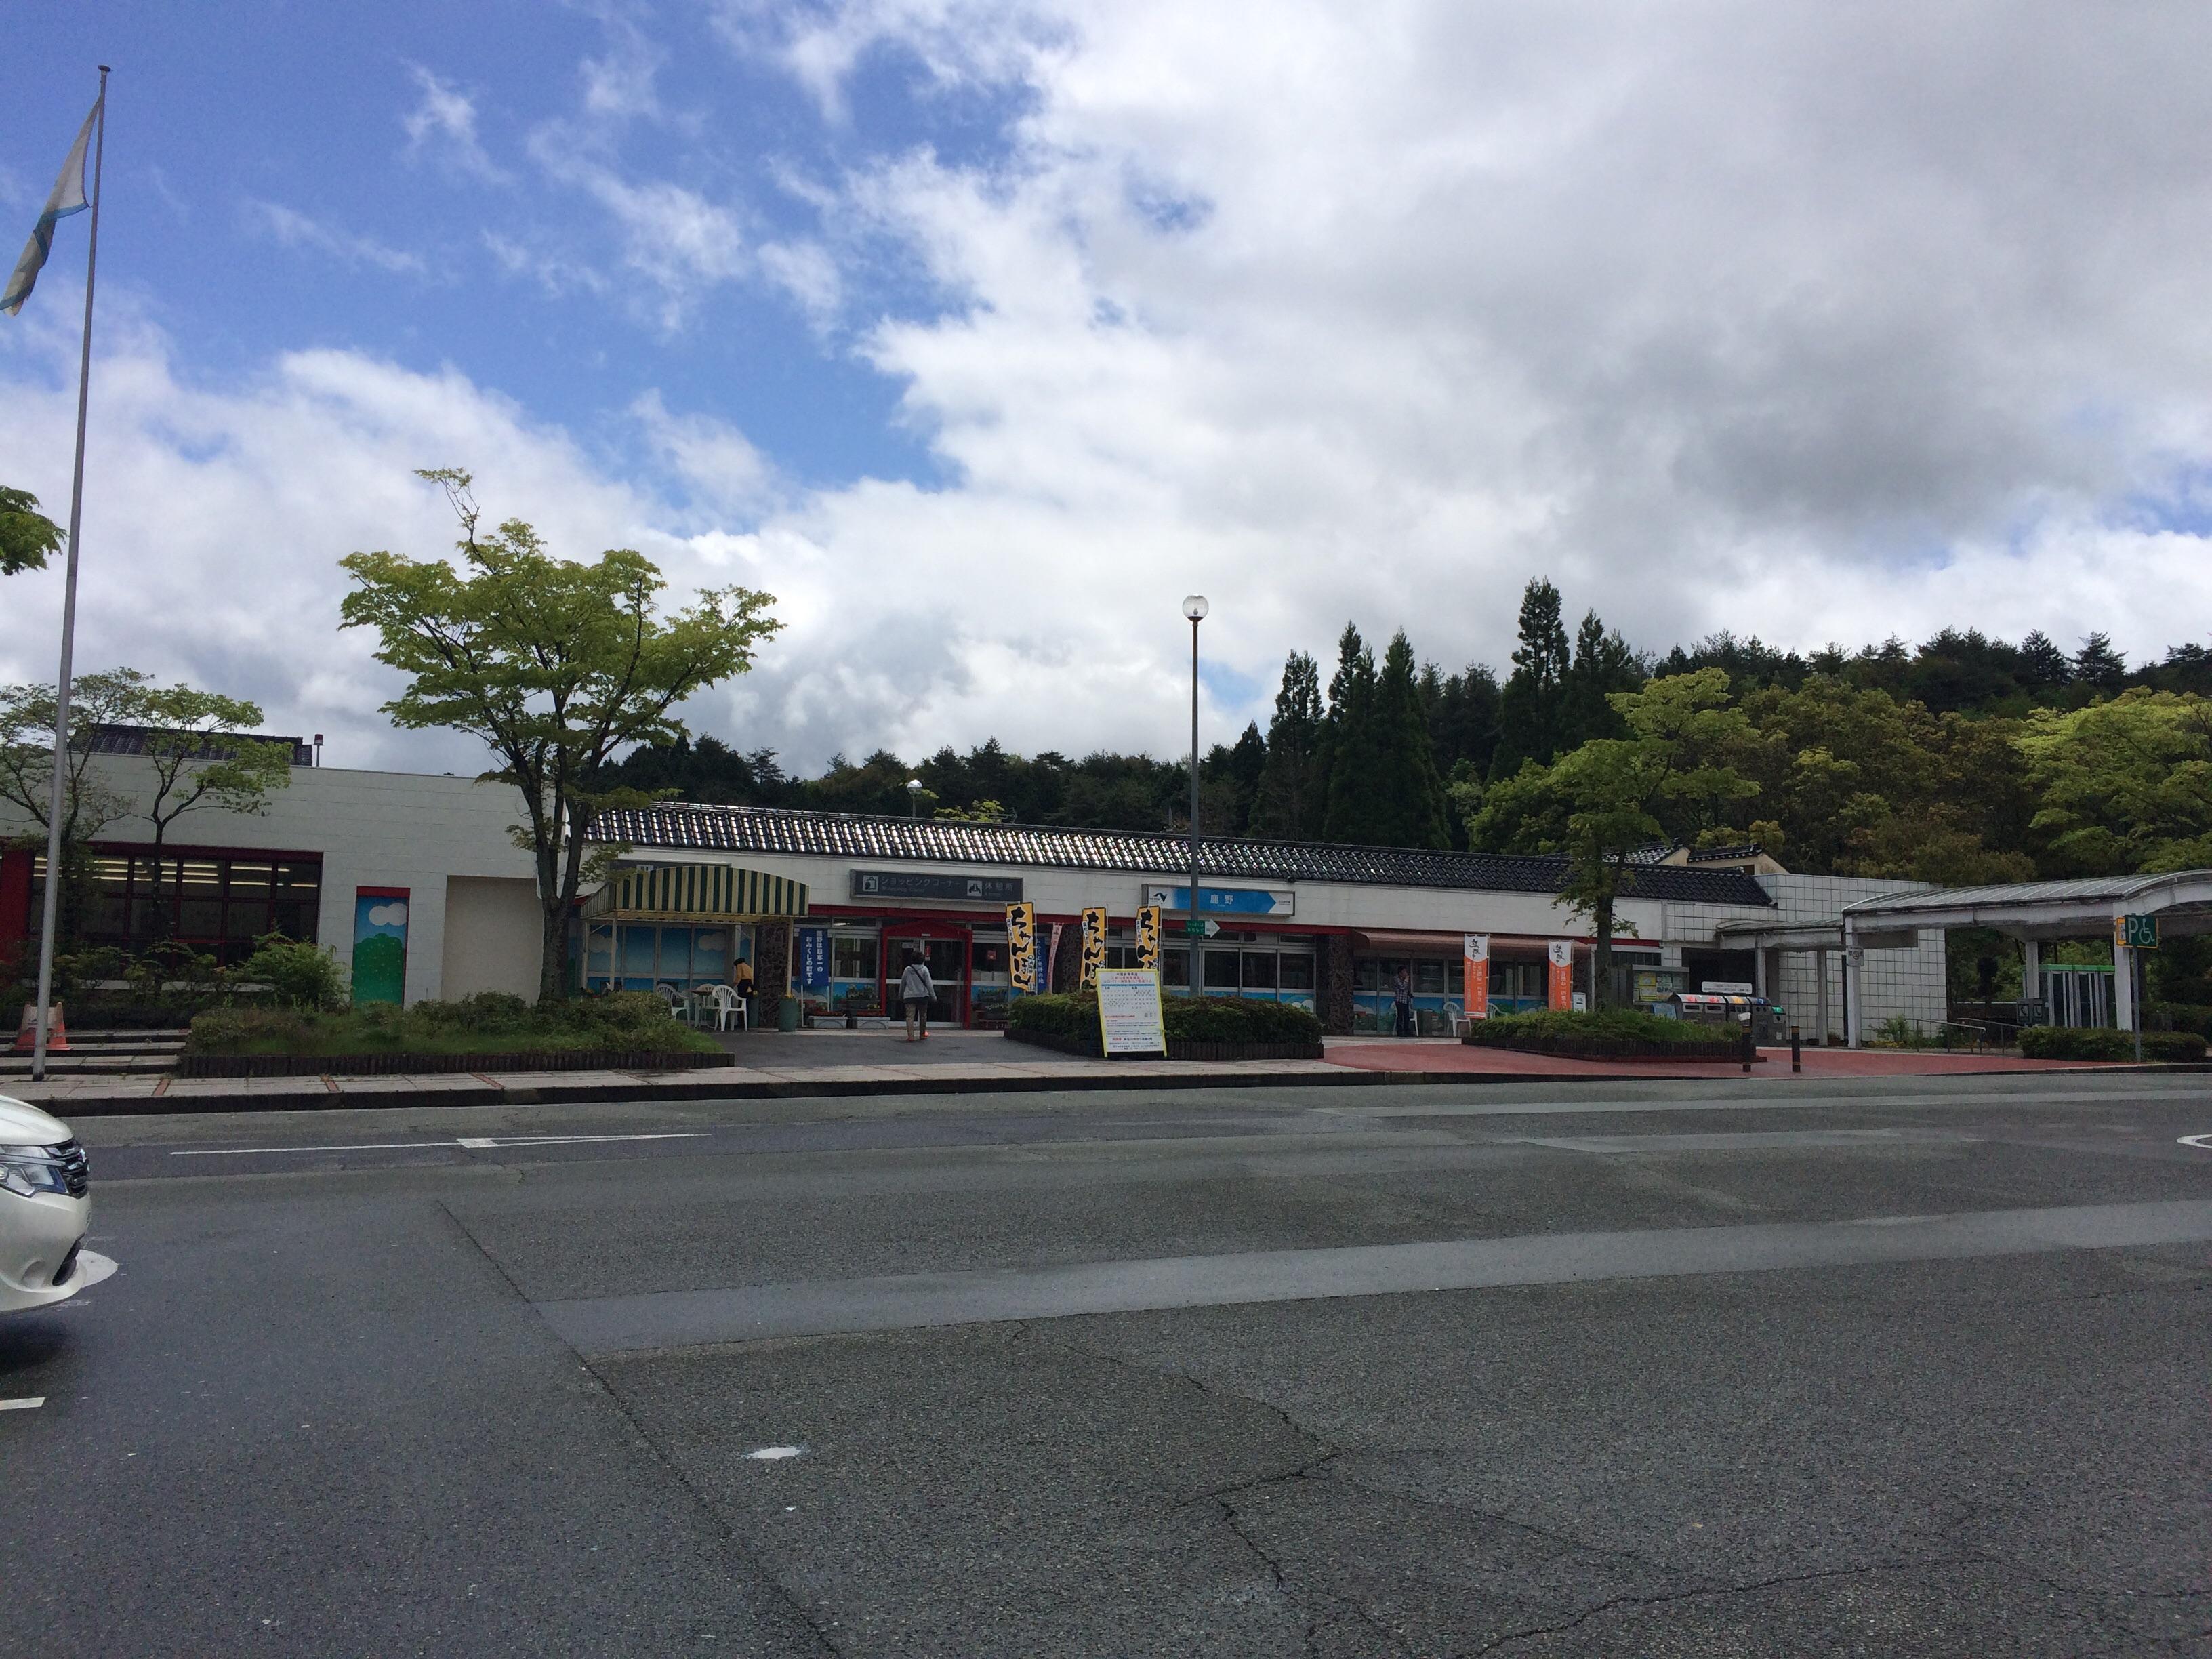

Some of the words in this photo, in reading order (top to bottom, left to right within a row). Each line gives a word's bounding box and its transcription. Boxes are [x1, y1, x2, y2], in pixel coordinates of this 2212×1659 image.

[881, 876, 960, 888] ショッピングコーナー
[1210, 894, 1234, 905] 鹿野
[2127, 917, 2139, 943] P
[1010, 905, 1032, 985] ちゃんぽん
